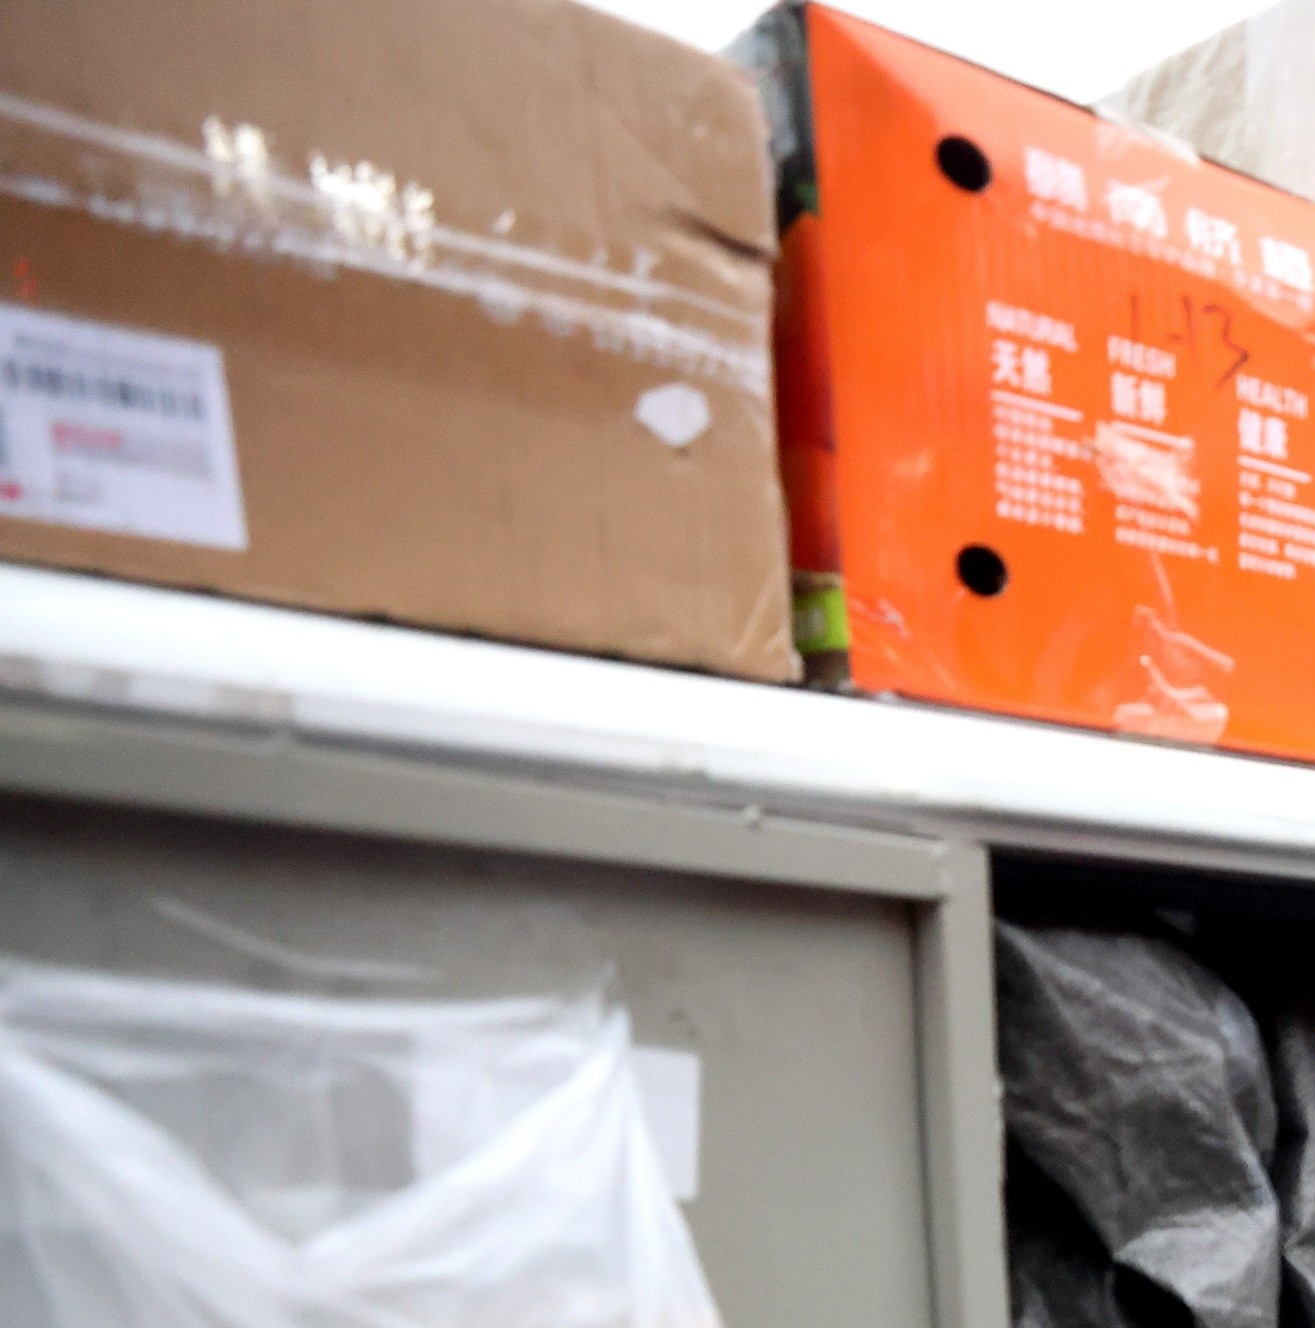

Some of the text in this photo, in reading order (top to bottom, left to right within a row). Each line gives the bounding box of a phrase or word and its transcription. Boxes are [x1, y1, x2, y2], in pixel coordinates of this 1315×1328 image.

[990, 338, 1051, 395] 天然
[1107, 335, 1176, 379] FRESH
[1110, 371, 1166, 425] 新鲜
[1236, 373, 1308, 419] HEALTH
[1238, 407, 1287, 459] 健康
